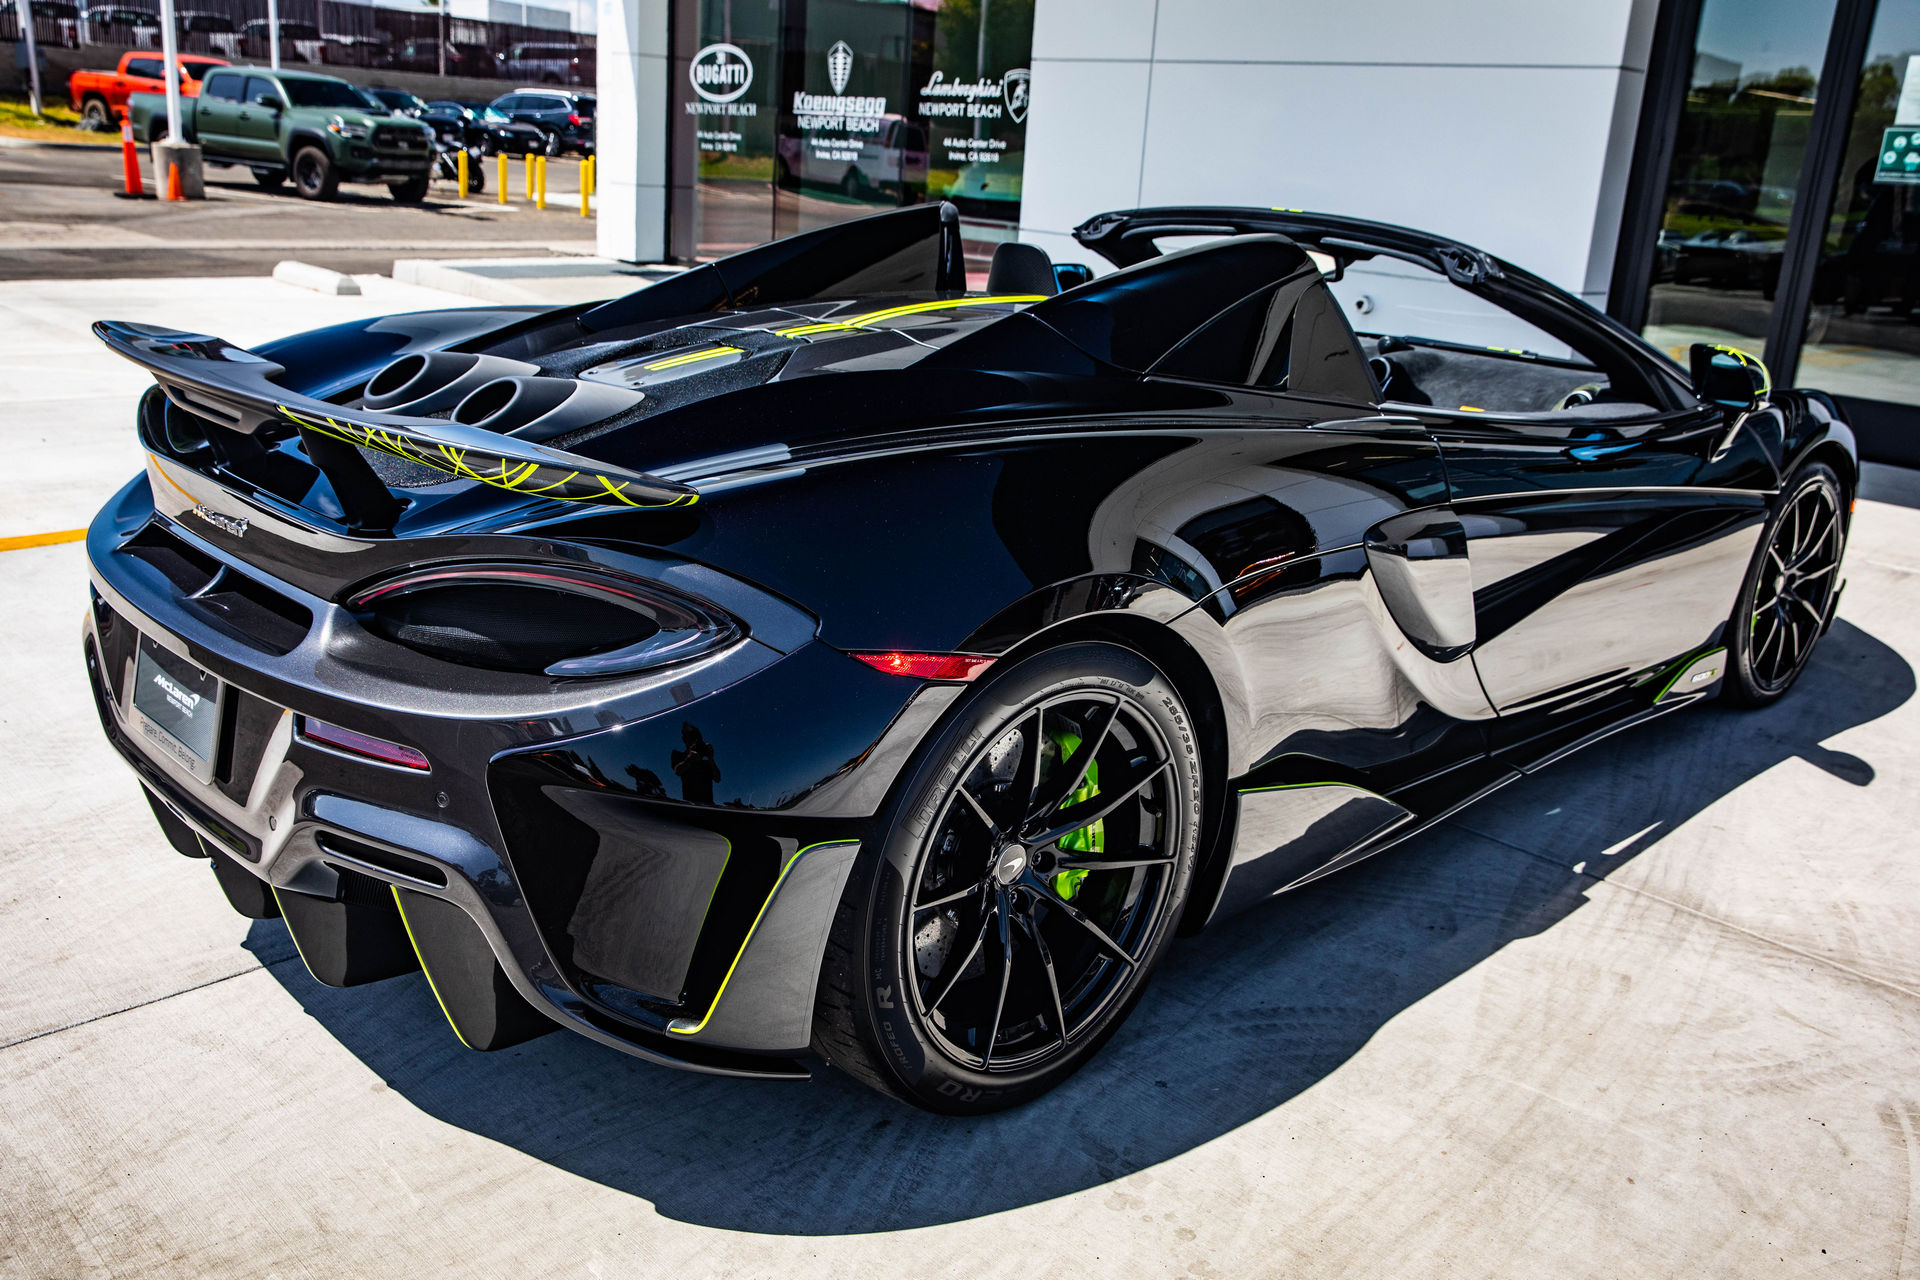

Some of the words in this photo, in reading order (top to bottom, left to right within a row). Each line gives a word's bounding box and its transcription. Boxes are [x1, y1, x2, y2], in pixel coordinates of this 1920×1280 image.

[696, 64, 744, 84] BUGATTI
[920, 70, 1003, 103] Lamborghini
[685, 102, 727, 115] NEWPORT
[728, 103, 757, 116] BEACH
[793, 91, 886, 118] Koenigsegg
[918, 102, 965, 117] NEWPORT
[966, 103, 1002, 118] BEACH
[797, 115, 845, 130] NEWPORT
[846, 117, 880, 133] BEACH
[153, 674, 194, 710] McLaren
[876, 984, 895, 1008] R
